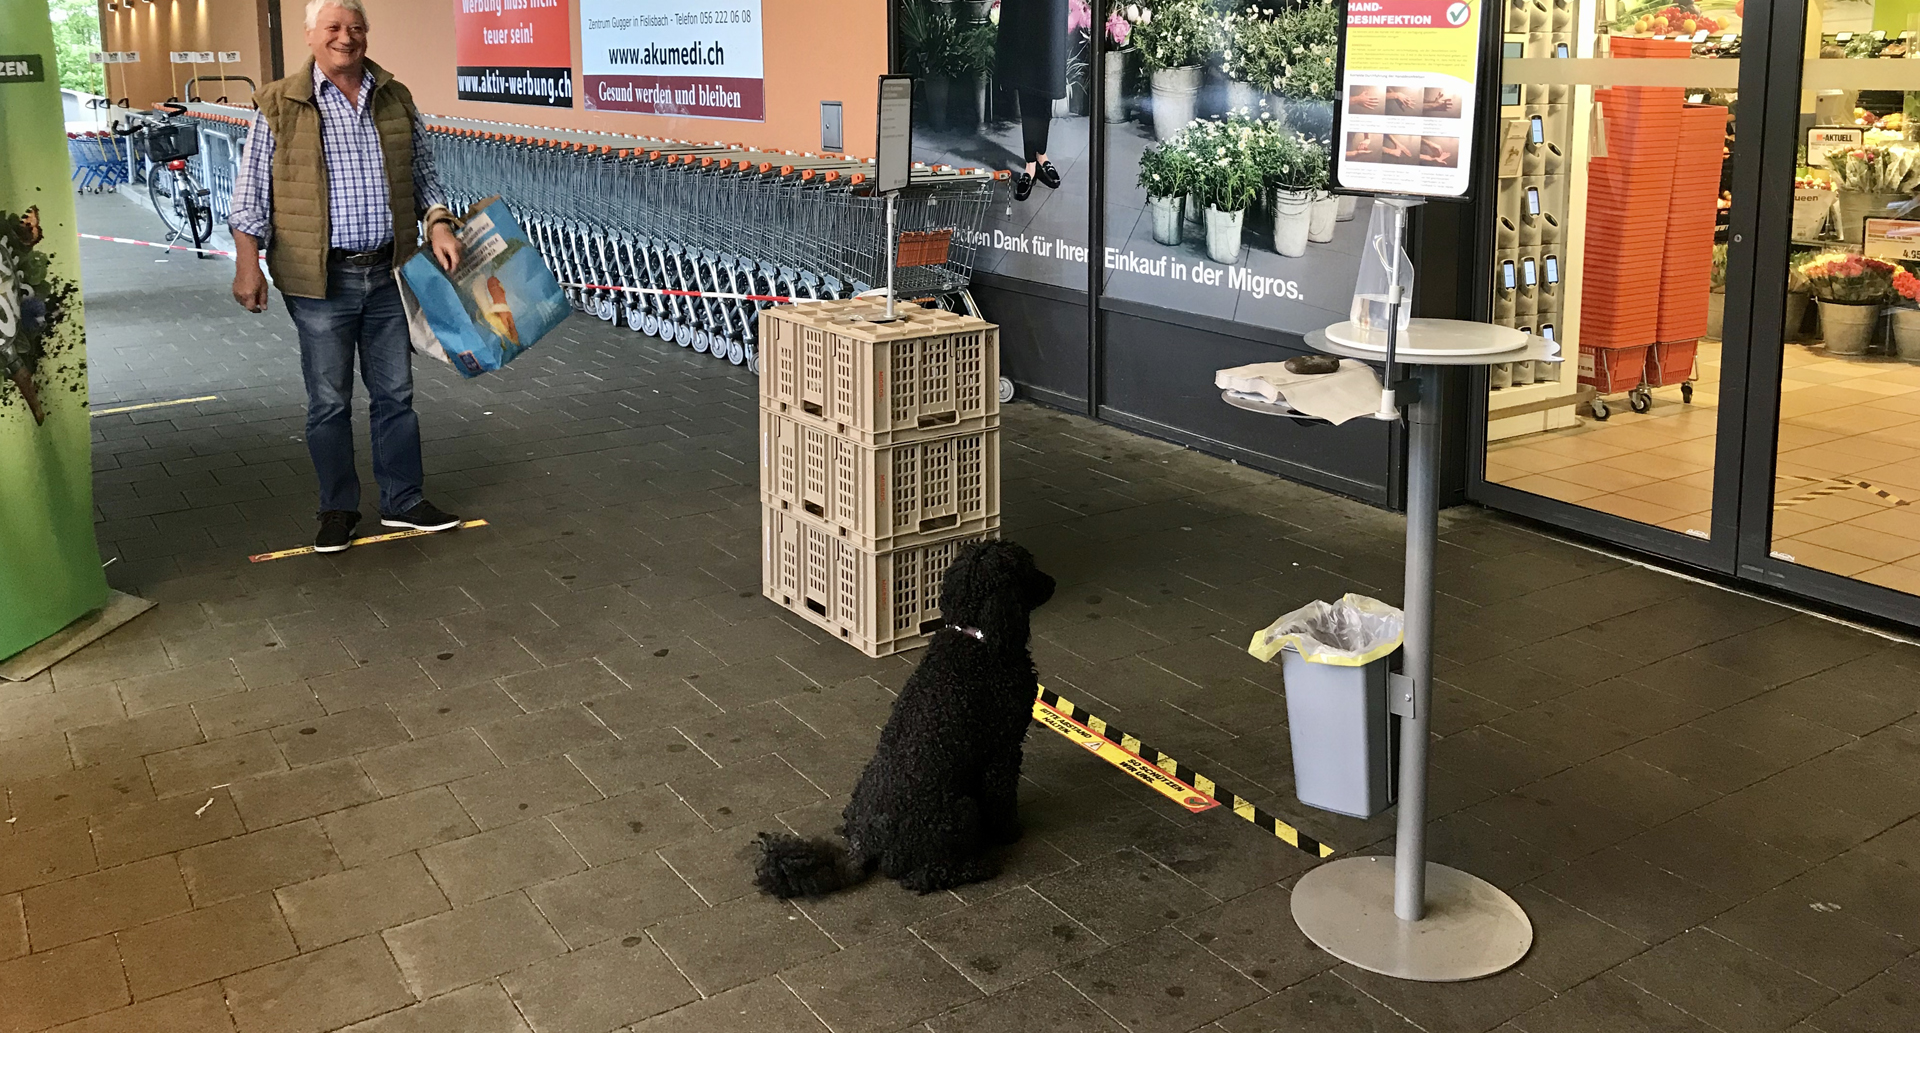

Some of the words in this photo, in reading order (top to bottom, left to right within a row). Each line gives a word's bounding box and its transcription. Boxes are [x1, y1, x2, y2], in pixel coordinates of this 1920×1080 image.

[461, 0, 502, 17] Werbung
[504, 0, 528, 10] muss
[1347, 2, 1383, 12] HAND-
[588, 18, 611, 30] Zentrum
[611, 16, 632, 31] Gugger
[633, 15, 639, 27] in
[640, 14, 669, 27] Fislisbach
[674, 12, 698, 26] Telefon
[699, 11, 713, 25] 056
[715, 10, 728, 24] 222
[730, 9, 740, 24] 06
[741, 9, 752, 23] 08
[1346, 14, 1432, 25] DESINFEKTION
[483, 26, 508, 45] teuer
[510, 21, 534, 44] sein!
[608, 40, 724, 66] www.akumedi.ch
[457, 68, 572, 104] www.aktiv-werbung.ch
[598, 81, 634, 103] Gesund
[635, 83, 672, 105] werden
[674, 83, 697, 106] und
[698, 83, 742, 109] bleiben
[1816, 133, 1853, 142] -AKTUELL
[1794, 194, 1819, 202] ueen
[993, 229, 1030, 254] Dank
[1031, 235, 1053, 257] für
[1104, 246, 1167, 277] Einkauf
[1171, 256, 1187, 281] in
[1191, 260, 1224, 287] der
[1228, 265, 1304, 301] Migros.
[1039, 707, 1060, 720] BITTE
[1058, 719, 1092, 739] ABSTAND
[1119, 761, 1138, 773] WIR
[1128, 758, 1141, 768] SO
